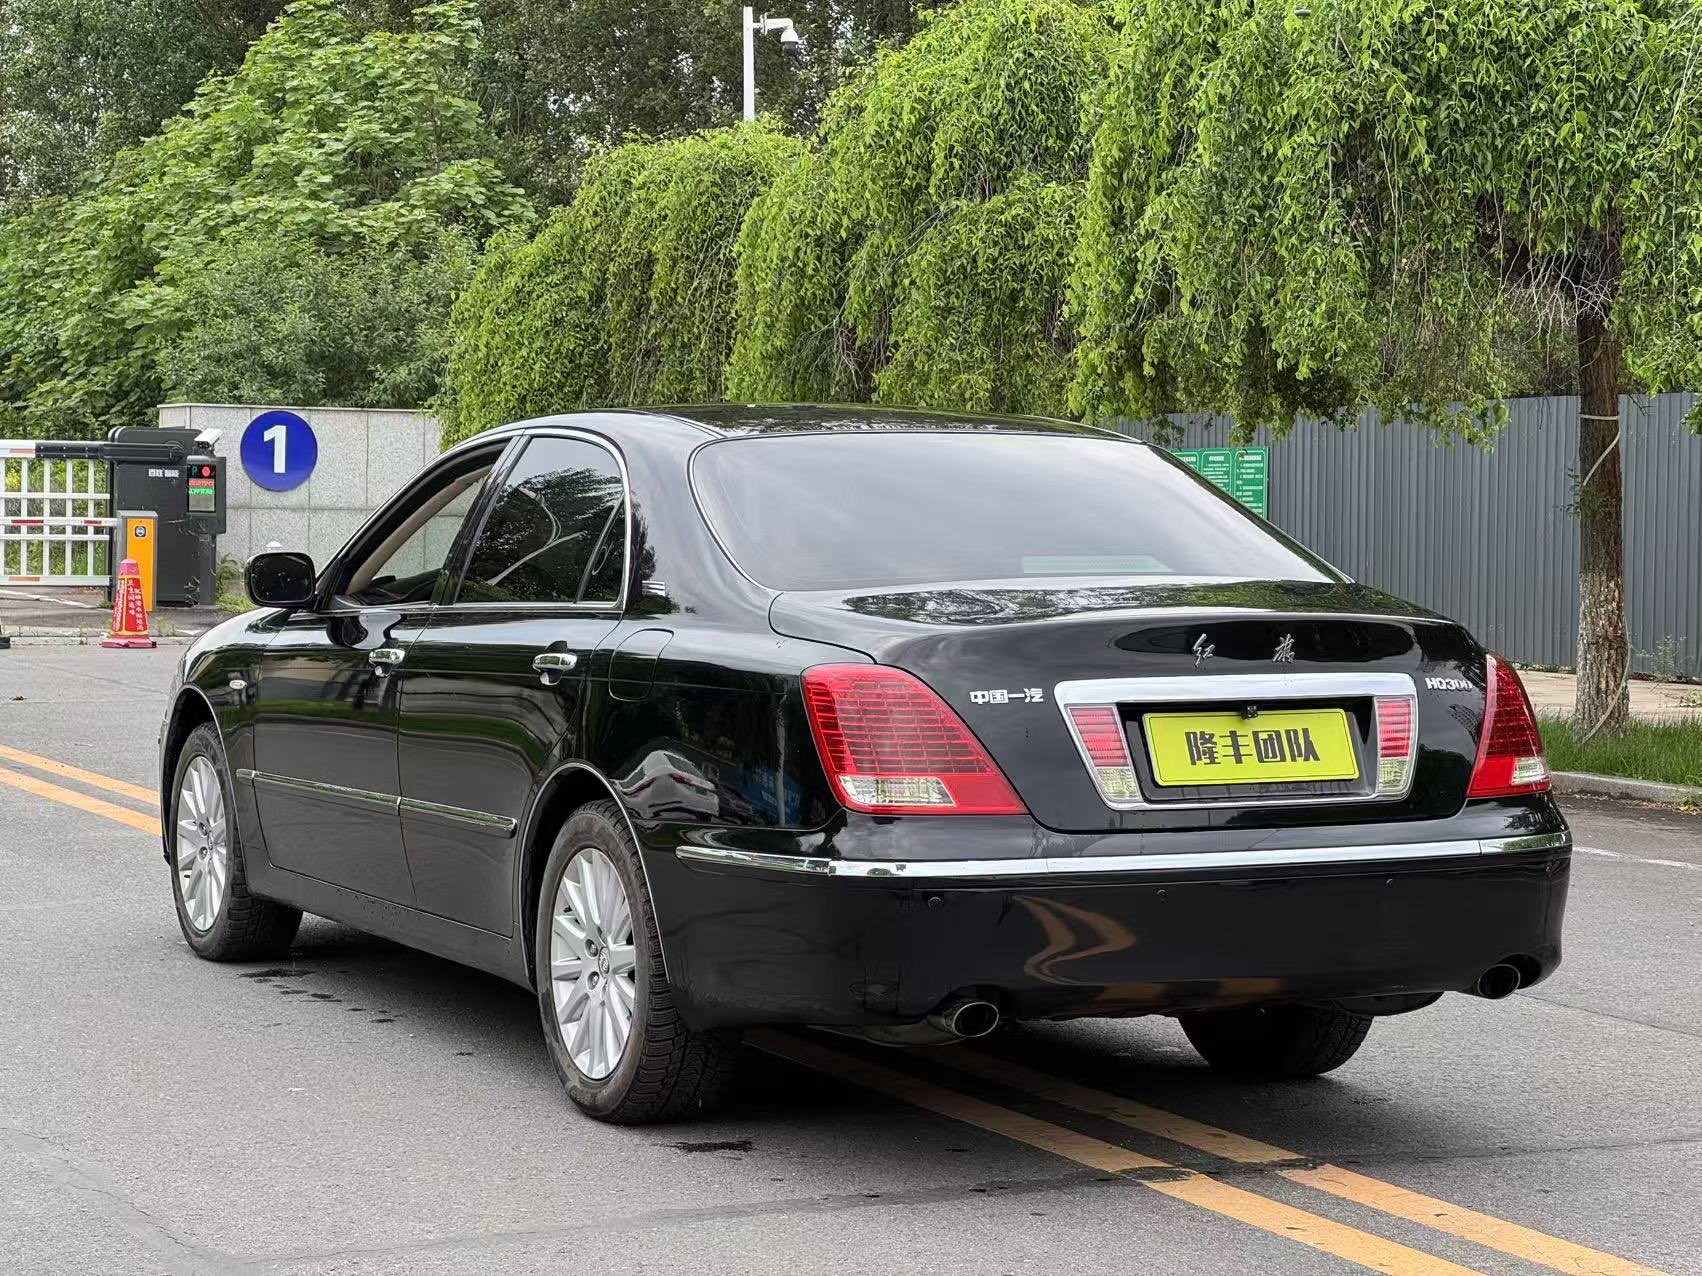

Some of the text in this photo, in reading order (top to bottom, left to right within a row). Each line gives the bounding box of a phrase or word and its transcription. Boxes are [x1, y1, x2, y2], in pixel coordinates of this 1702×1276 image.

[262, 424, 287, 474] 1
[1192, 633, 1296, 668] 红旗
[969, 688, 1044, 704] 中国一汽
[1425, 677, 1474, 691] HQ300
[1184, 727, 1321, 766] 隆丰团队
